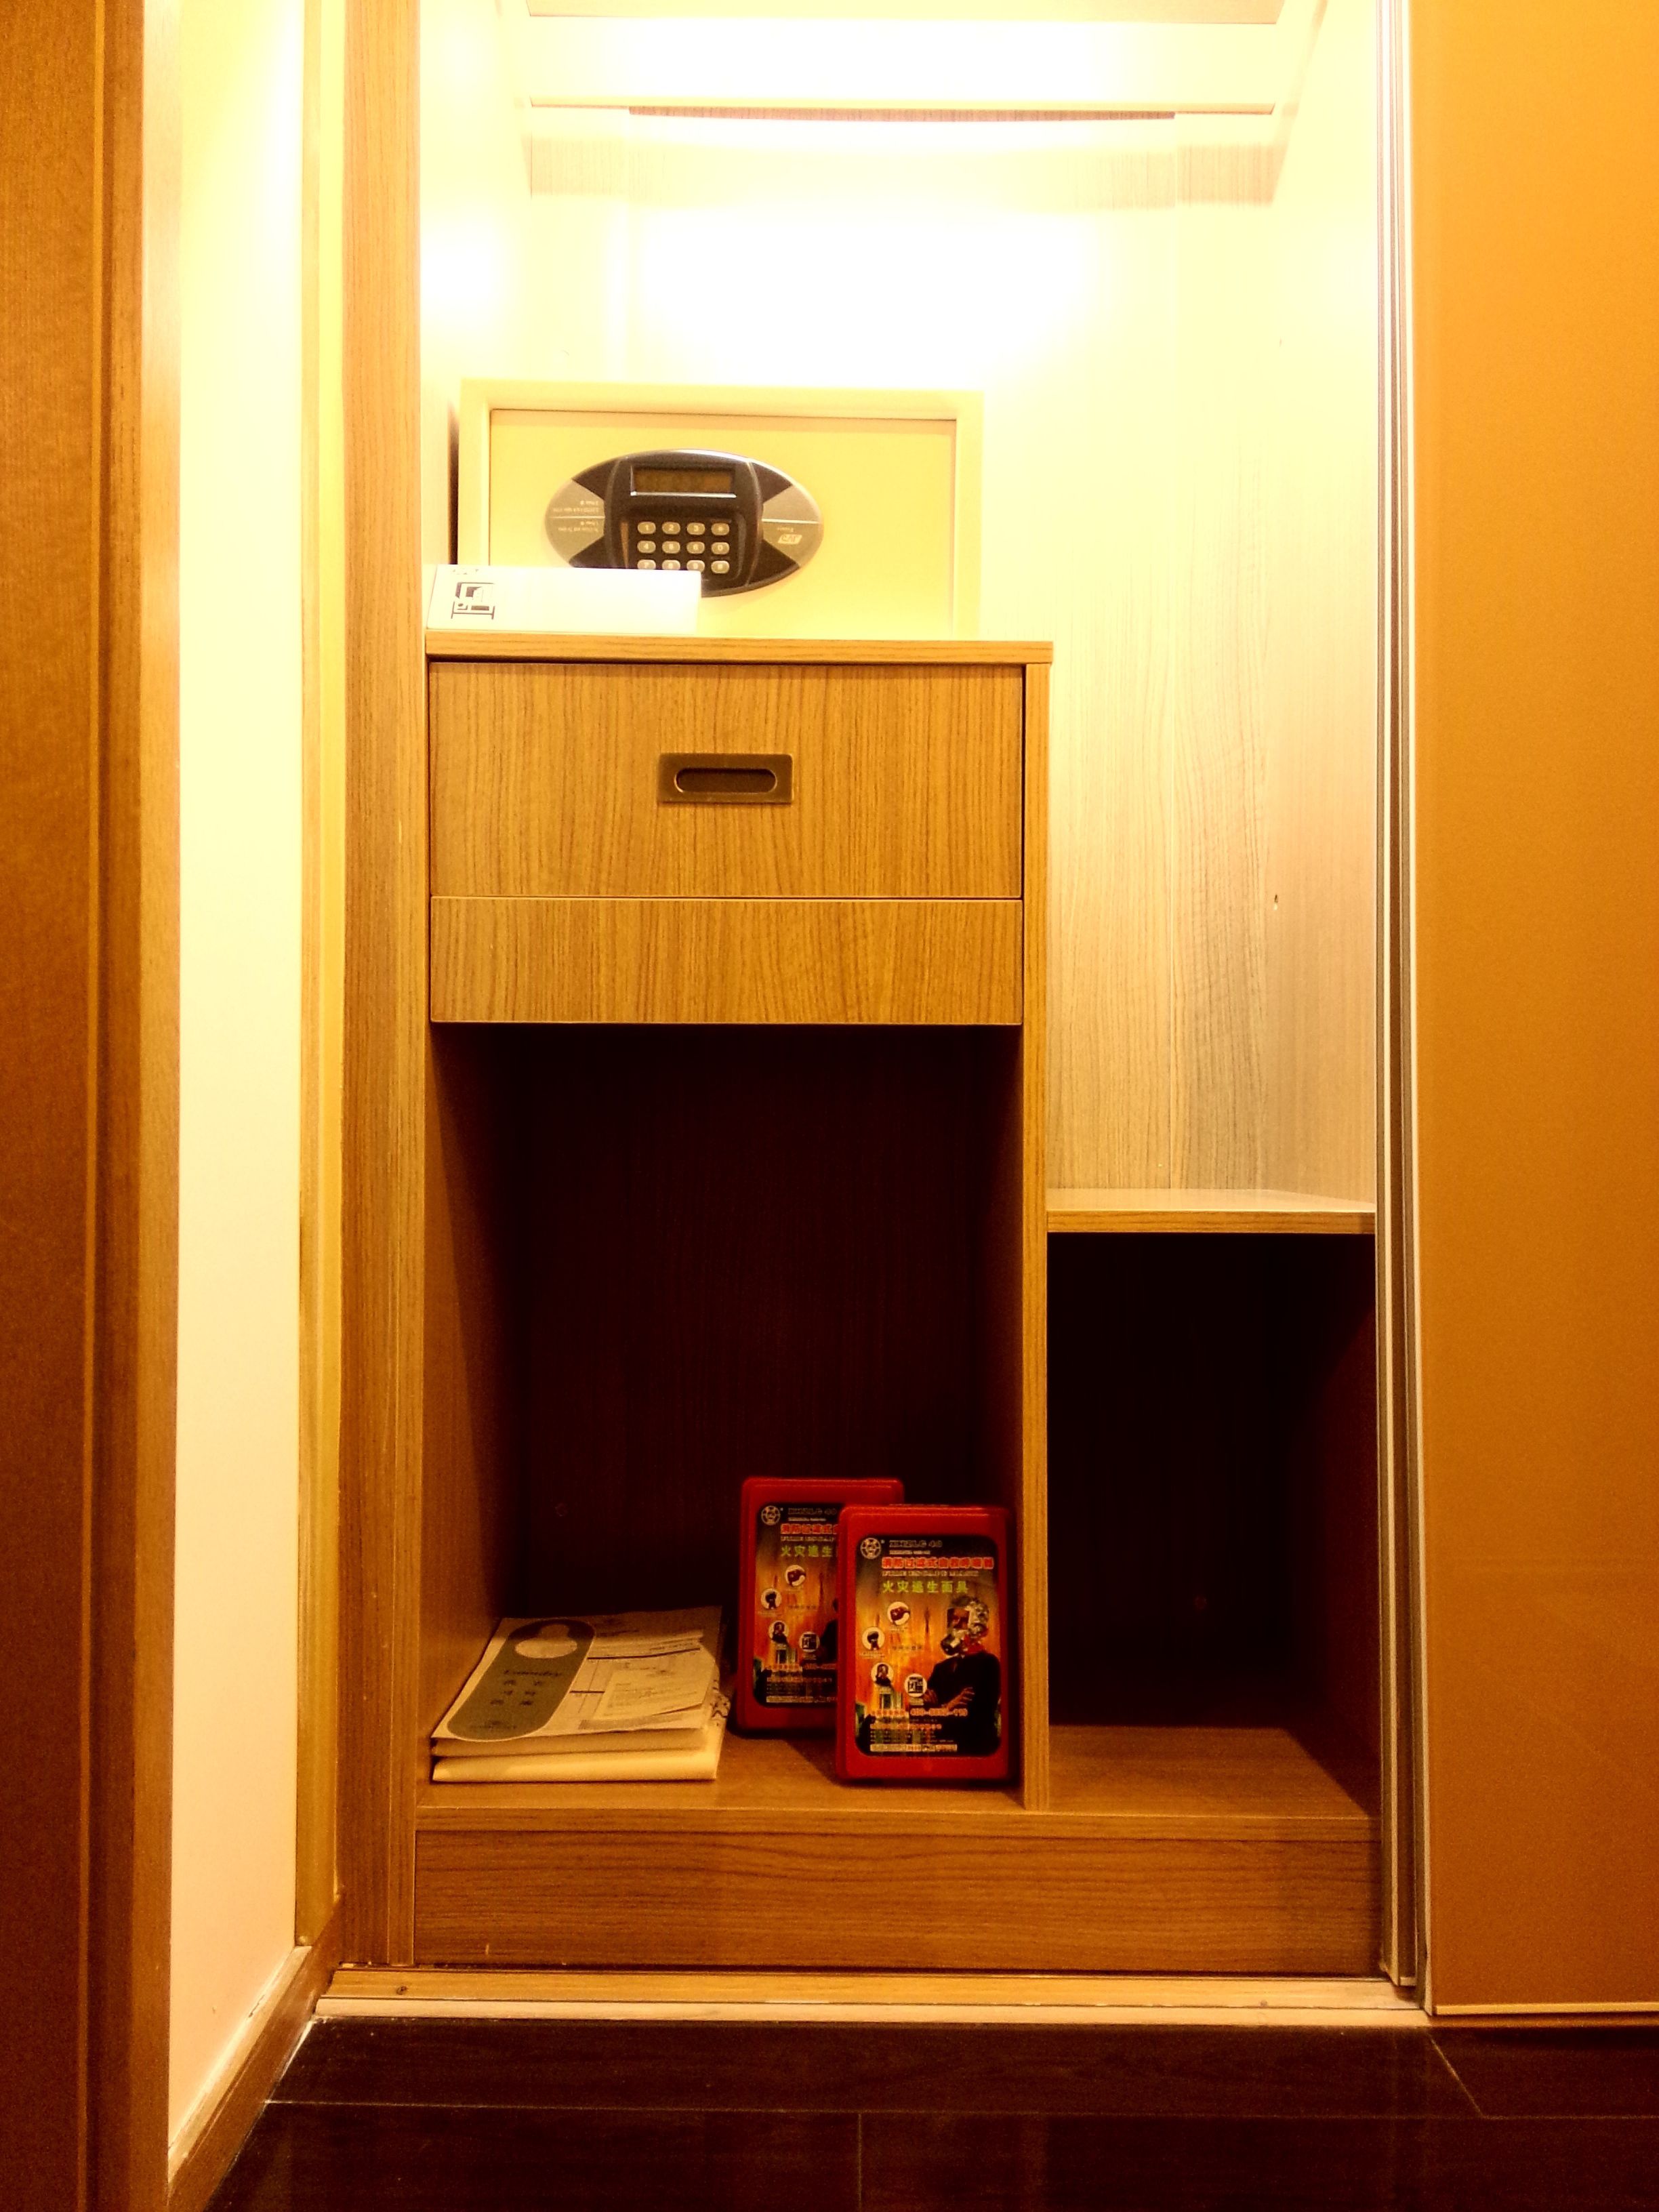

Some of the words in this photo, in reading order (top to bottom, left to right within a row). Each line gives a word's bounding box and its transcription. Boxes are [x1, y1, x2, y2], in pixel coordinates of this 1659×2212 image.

[882, 1580, 969, 1593] 火灾逃生面具
